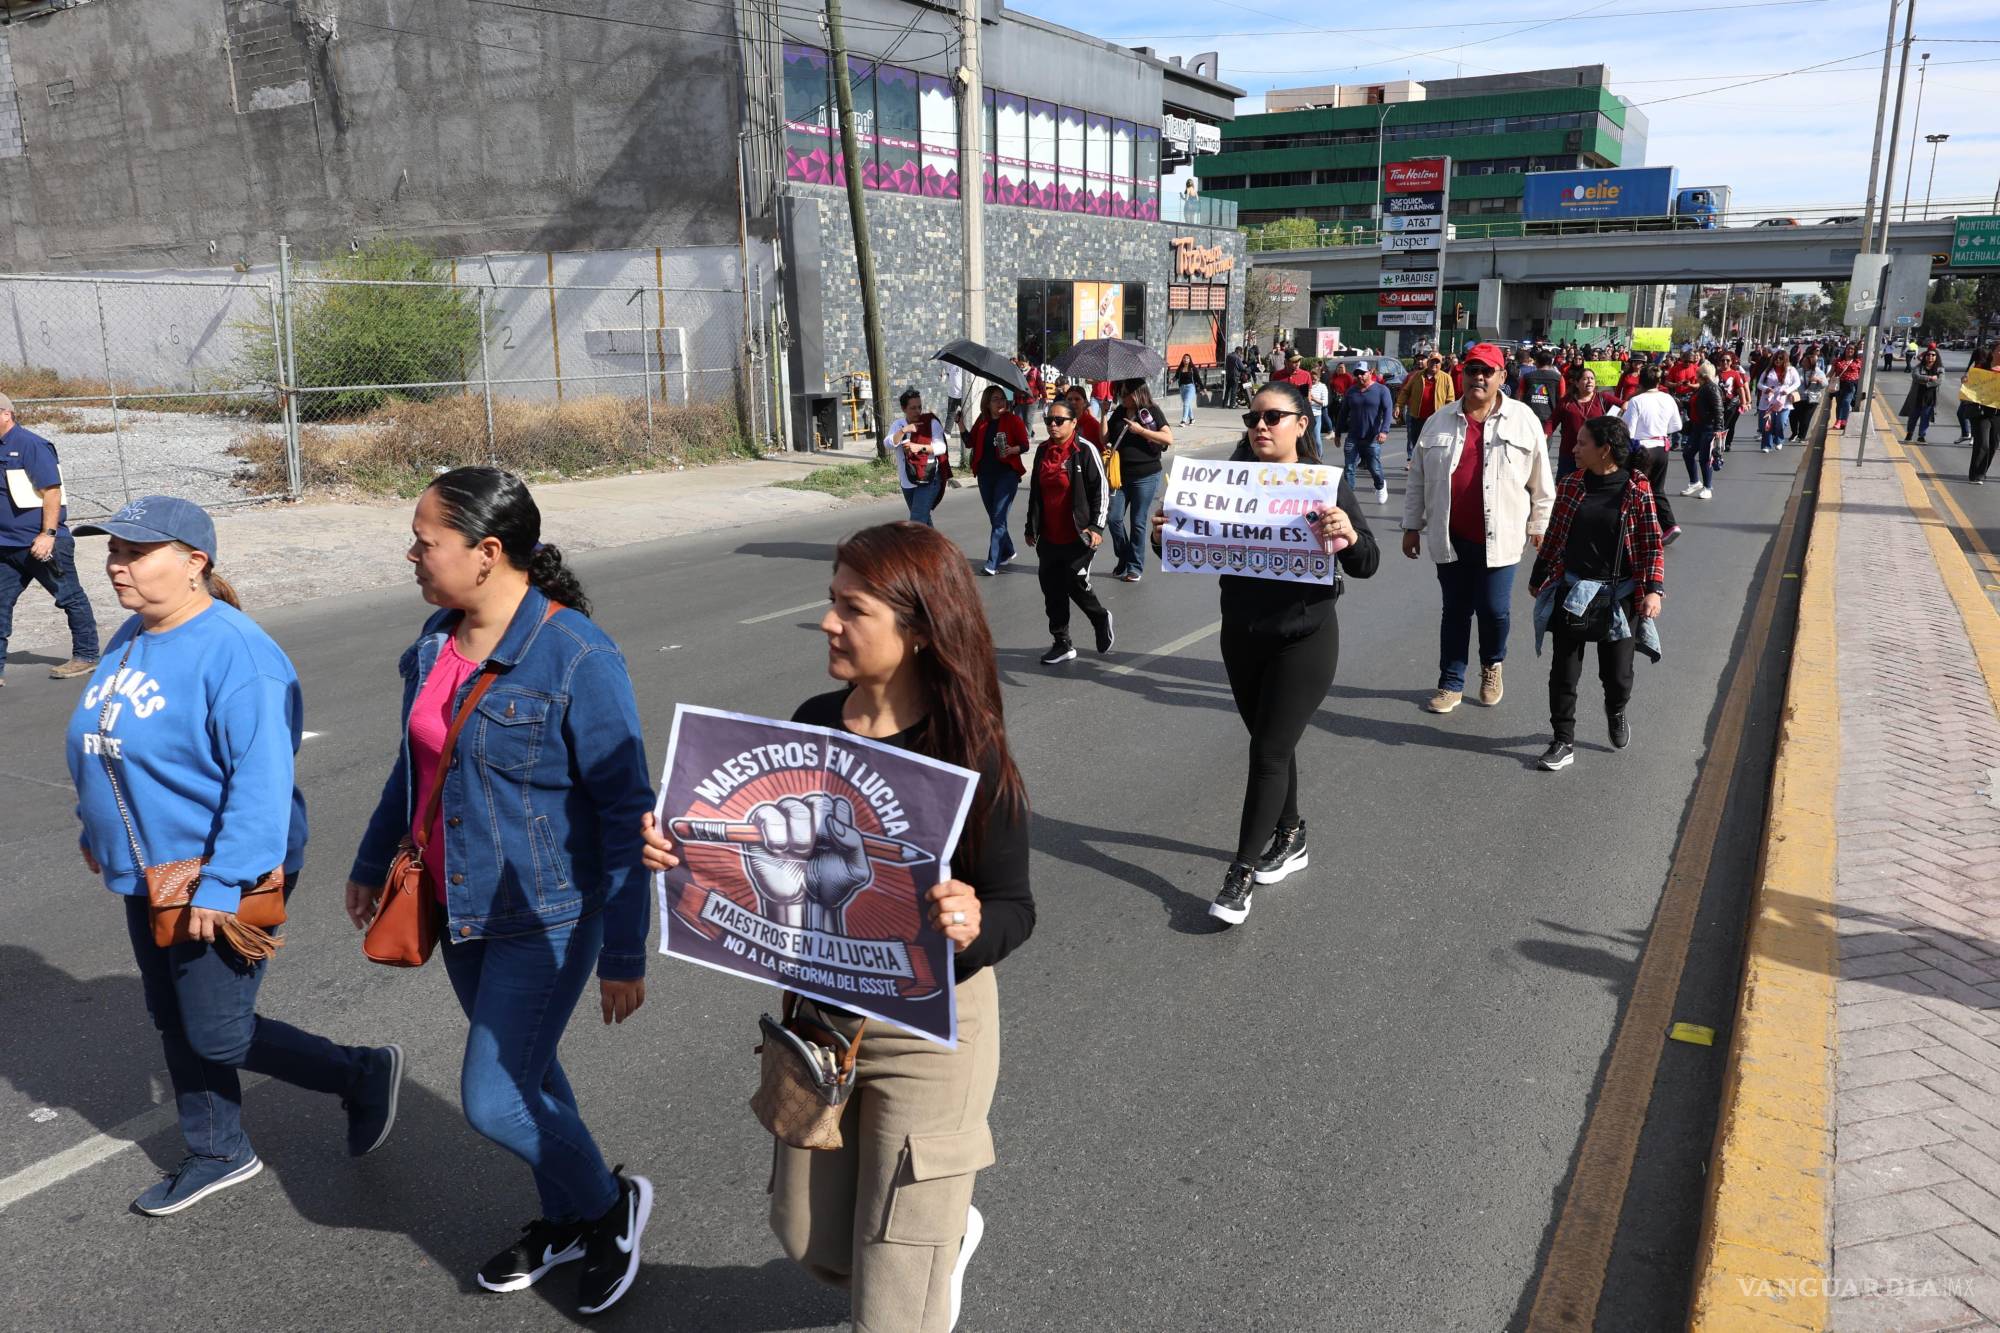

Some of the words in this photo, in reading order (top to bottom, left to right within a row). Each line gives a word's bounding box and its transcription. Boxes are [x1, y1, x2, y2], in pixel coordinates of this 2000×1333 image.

[1390, 168, 1406, 181] Tim
[1406, 168, 1439, 180] Hortons
[1402, 197, 1424, 206] QUICK
[1402, 202, 1434, 211] LEARNING
[1406, 217, 1432, 228] AT&T
[1391, 235, 1430, 251] jasper
[1395, 273, 1434, 284] PARADISE
[1401, 294, 1411, 302] LA
[1411, 293, 1434, 302] CHAPU
[502, 325, 515, 350] 2
[1181, 465, 1221, 482] HOY
[1226, 468, 1249, 486] LA
[1257, 468, 1329, 486] CLASE
[1176, 491, 1198, 507] ES
[1204, 494, 1229, 510] EN
[1234, 497, 1258, 514] LA
[1175, 517, 1187, 532] Y
[1193, 519, 1212, 537] EL
[1220, 522, 1273, 541] TEMA
[1279, 527, 1308, 542] ES:
[1171, 546, 1326, 572] DIGNIDAD
[693, 741, 819, 806] MAESTROS
[826, 746, 855, 779] EN
[854, 762, 912, 838] LUCHA
[710, 897, 790, 951] MAESTROS
[791, 932, 813, 957] EN
[817, 937, 837, 963] LA
[836, 939, 902, 972] LUCHA
[722, 934, 746, 955] NO
[747, 946, 759, 963] A
[760, 951, 777, 971] LA
[778, 960, 837, 989] REFORMA
[836, 972, 857, 992] DEL
[858, 975, 899, 998] ISSSTE
